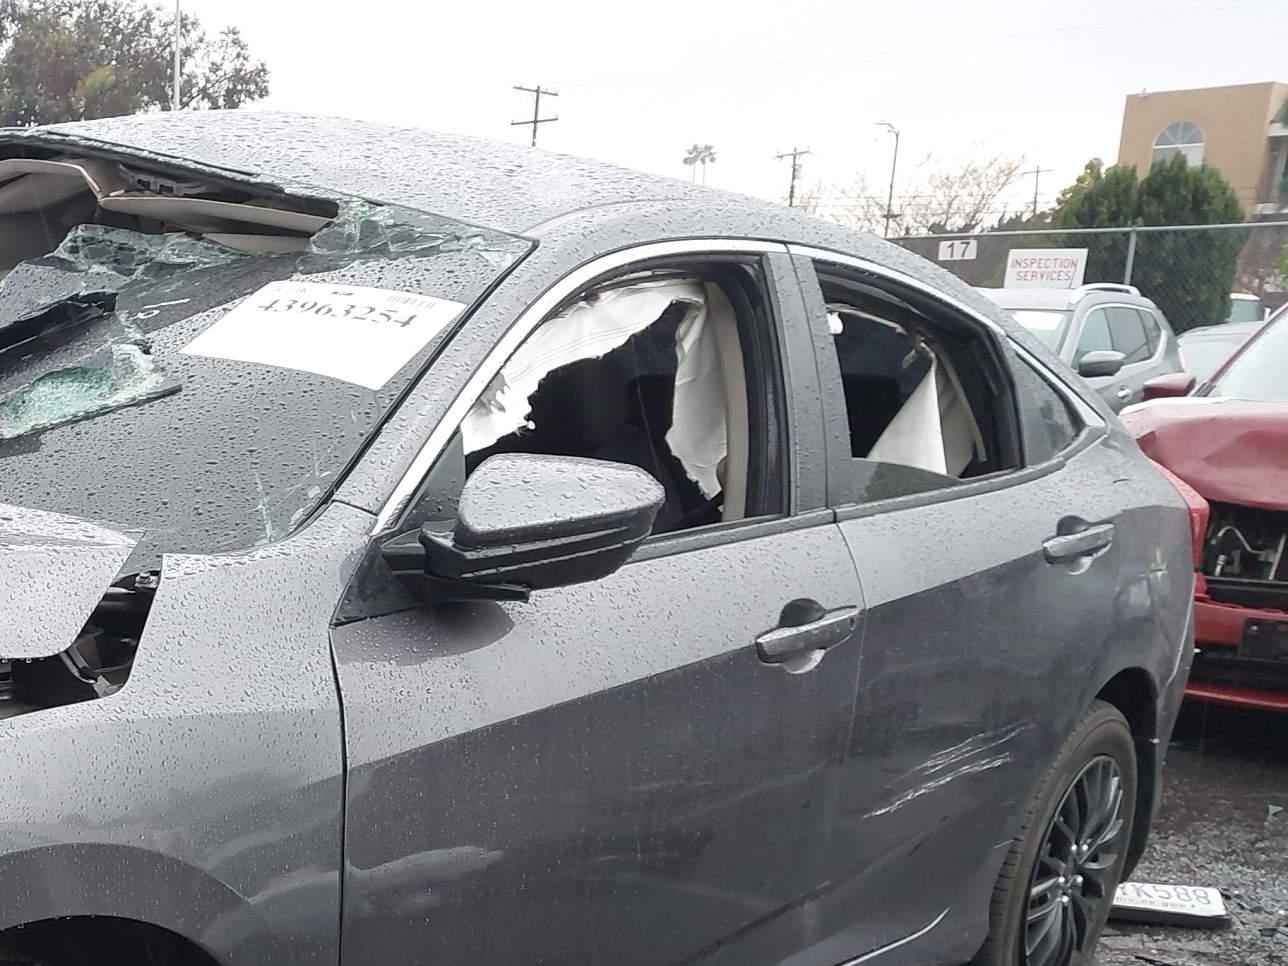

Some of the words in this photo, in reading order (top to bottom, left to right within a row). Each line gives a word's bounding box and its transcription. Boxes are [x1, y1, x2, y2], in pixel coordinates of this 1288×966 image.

[947, 241, 970, 258] 17
[1011, 257, 1079, 269] INSPECTION
[1016, 270, 1072, 281] SERVICES
[257, 298, 418, 328] 43963254
